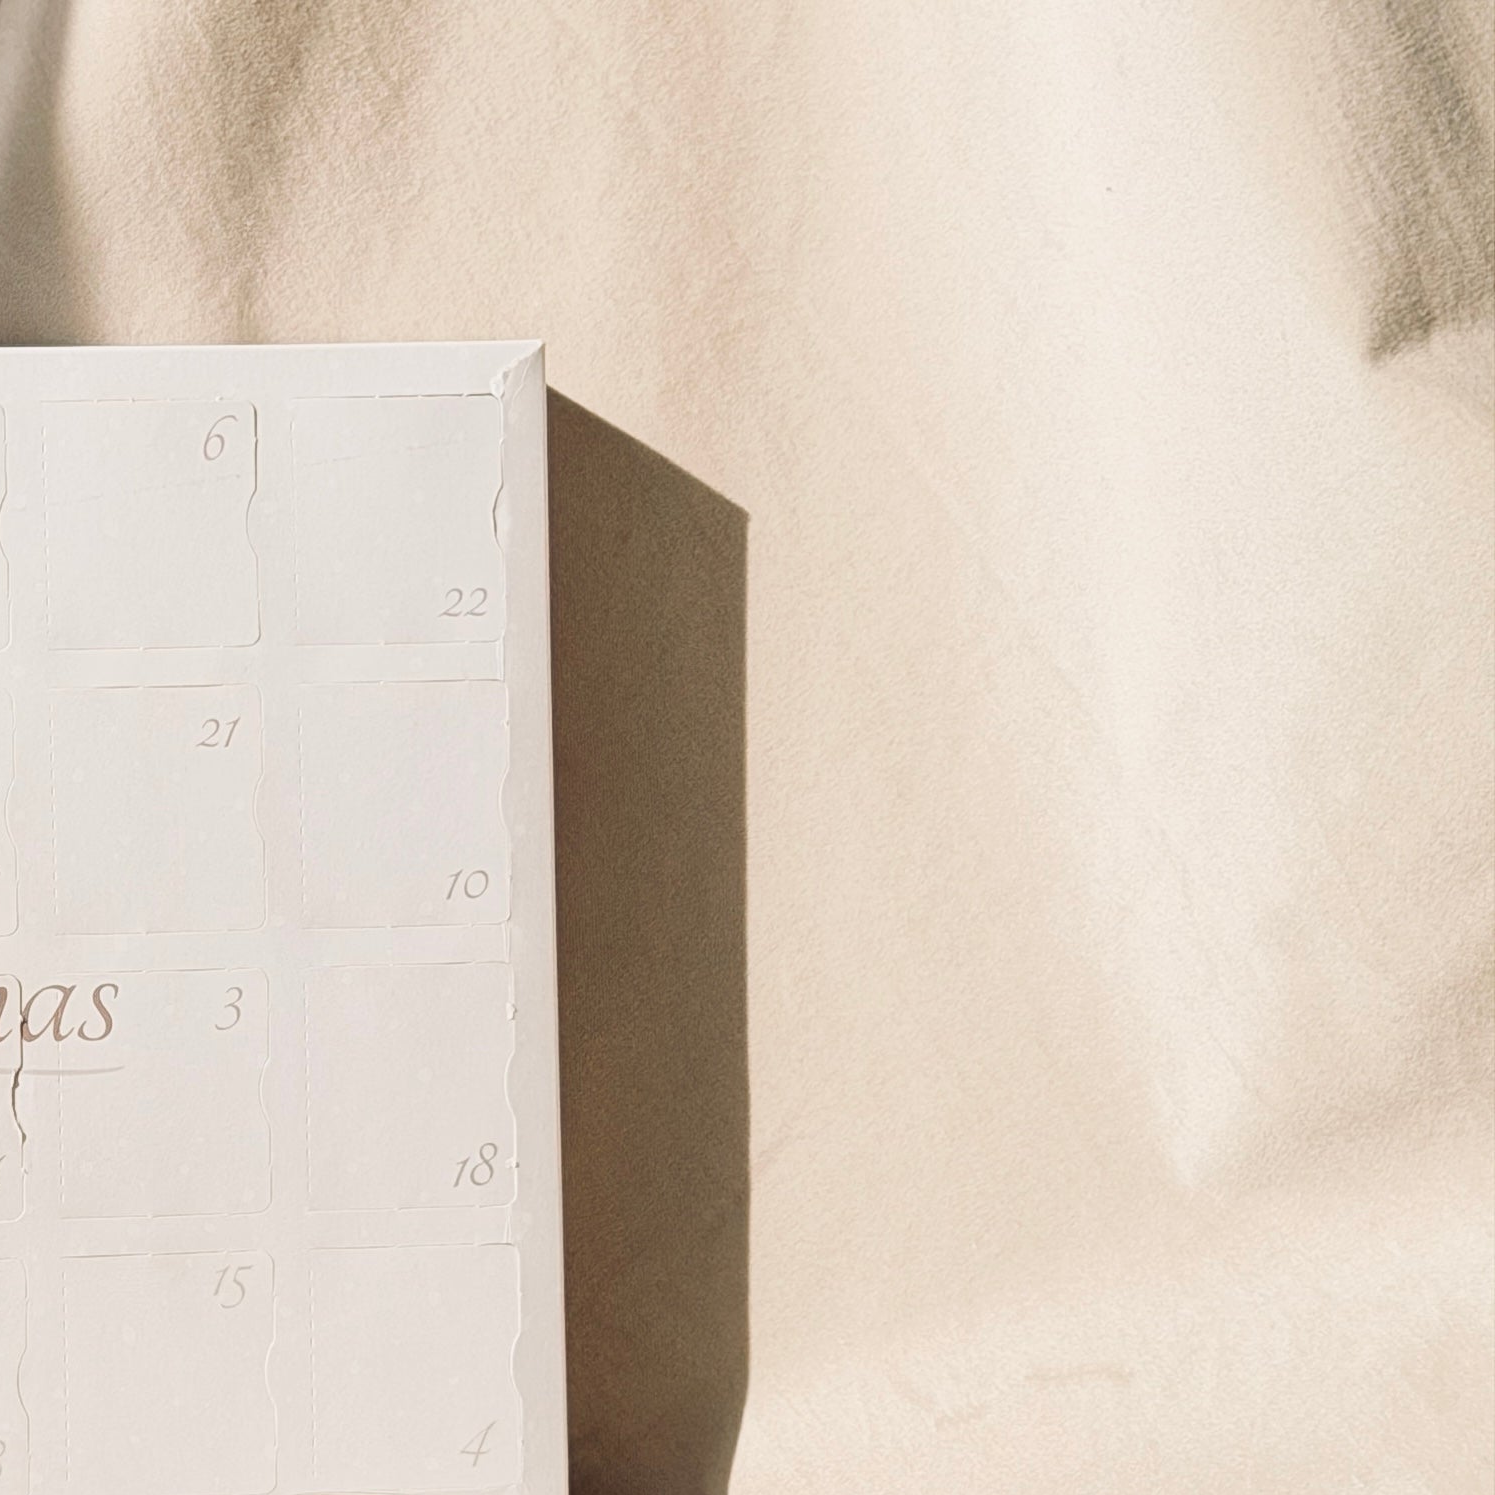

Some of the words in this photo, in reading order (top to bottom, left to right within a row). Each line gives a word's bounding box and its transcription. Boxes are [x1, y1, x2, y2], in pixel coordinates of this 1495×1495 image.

[203, 414, 237, 461] 6
[438, 587, 488, 618] 22
[196, 717, 240, 749] 21
[443, 868, 488, 901] 10
[213, 986, 244, 1031] 3
[452, 1142, 498, 1188] 18
[212, 1264, 254, 1309] 15
[459, 1420, 496, 1468] 4
